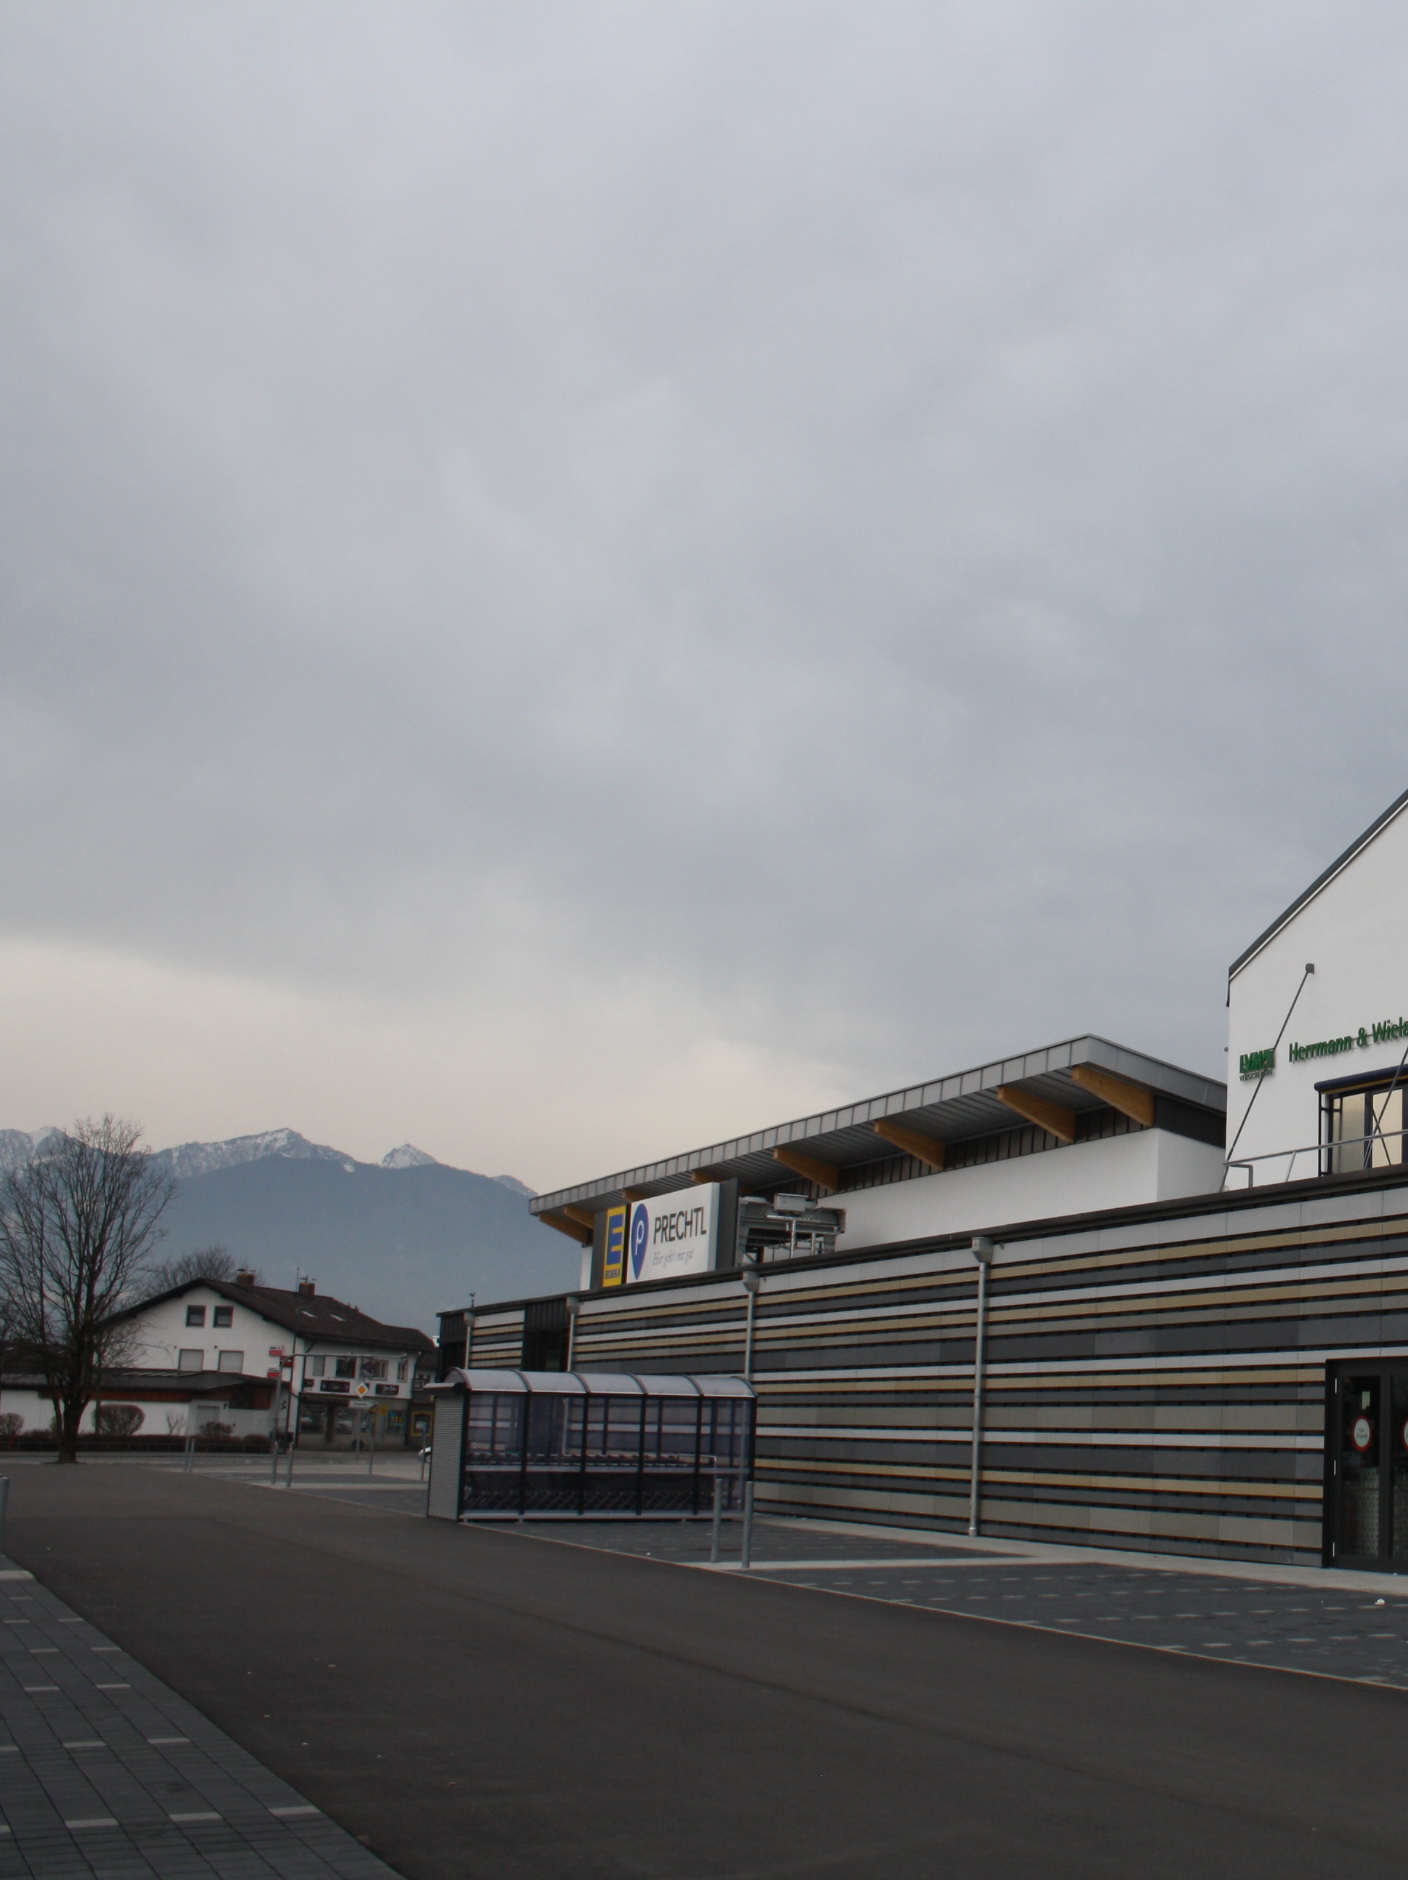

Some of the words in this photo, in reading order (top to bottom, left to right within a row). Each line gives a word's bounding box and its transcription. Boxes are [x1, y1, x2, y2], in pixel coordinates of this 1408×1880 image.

[1289, 1035, 1352, 1062] Herrmann
[1356, 1027, 1368, 1047] &
[653, 1206, 707, 1244] PRECHTL
[605, 1269, 621, 1279] EDEKA
